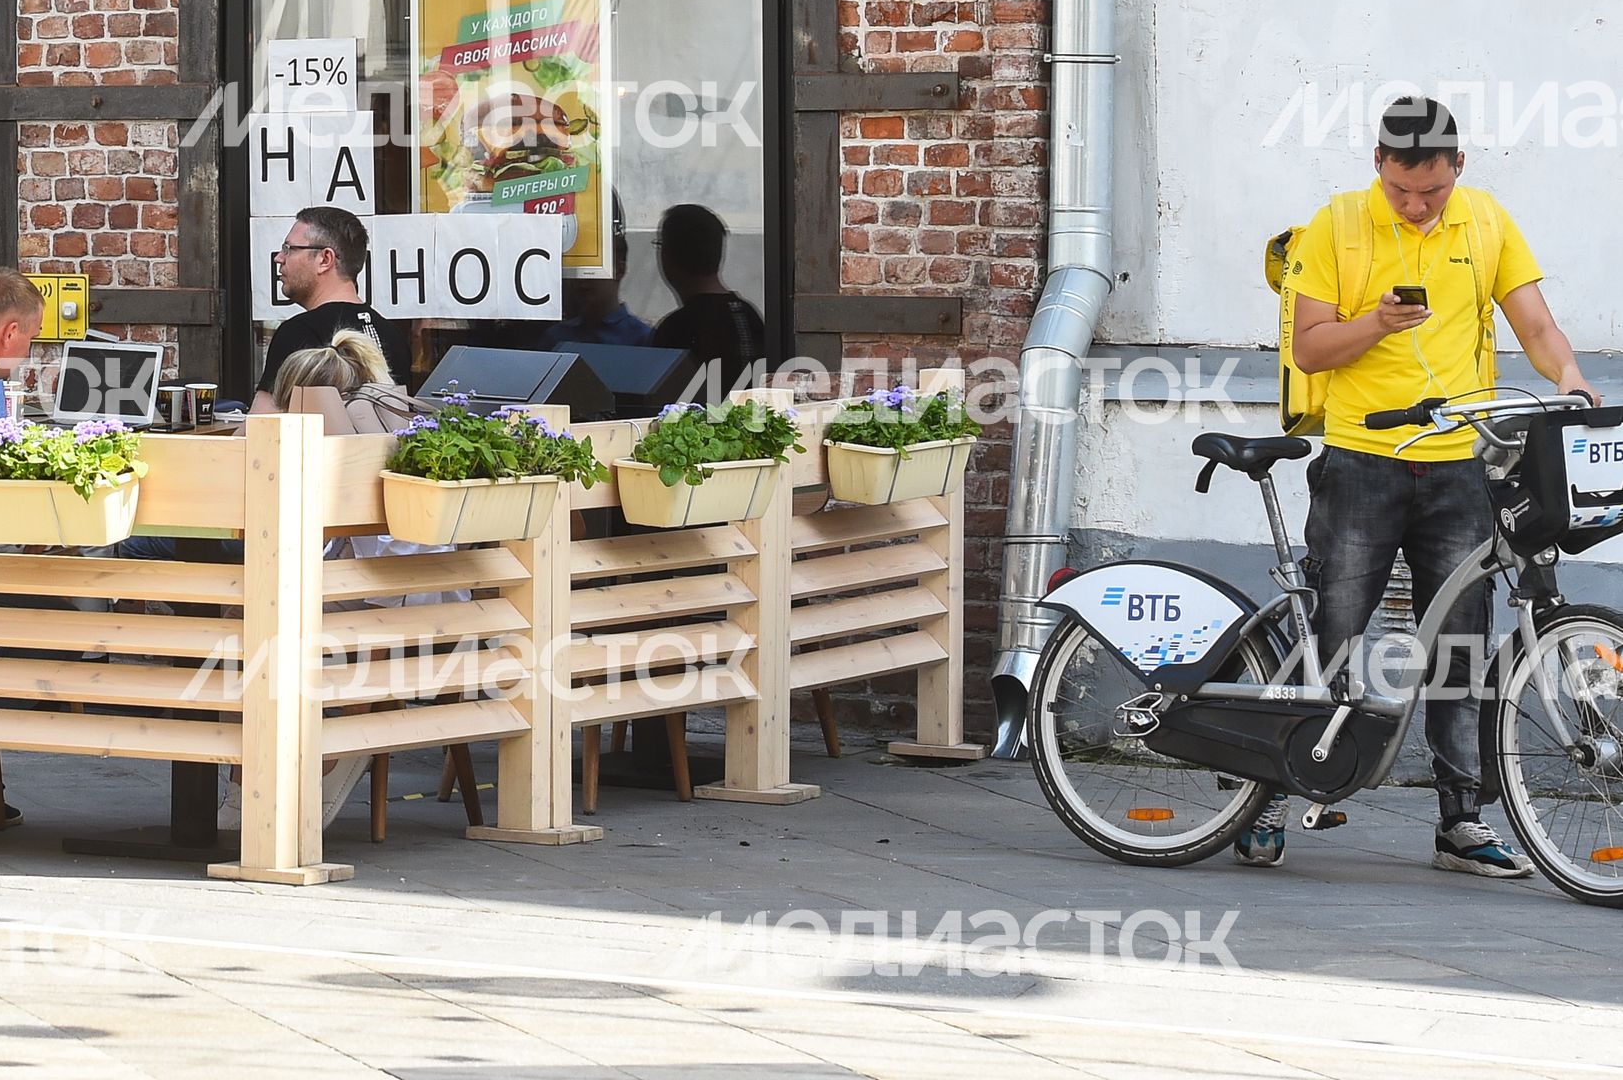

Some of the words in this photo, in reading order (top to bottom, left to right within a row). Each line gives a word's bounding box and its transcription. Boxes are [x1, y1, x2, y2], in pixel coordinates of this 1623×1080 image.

[471, 21, 480, 36] У
[482, 7, 548, 33] КАЖДОГО
[454, 46, 490, 67] СВОЯ
[493, 31, 569, 59] КЛАССИКА
[275, 56, 348, 86] -15%
[502, 178, 558, 199] БУРГЕРЫ
[561, 174, 577, 188] ОТ
[534, 200, 557, 214] 190
[1127, 593, 1182, 622] ВТБ
